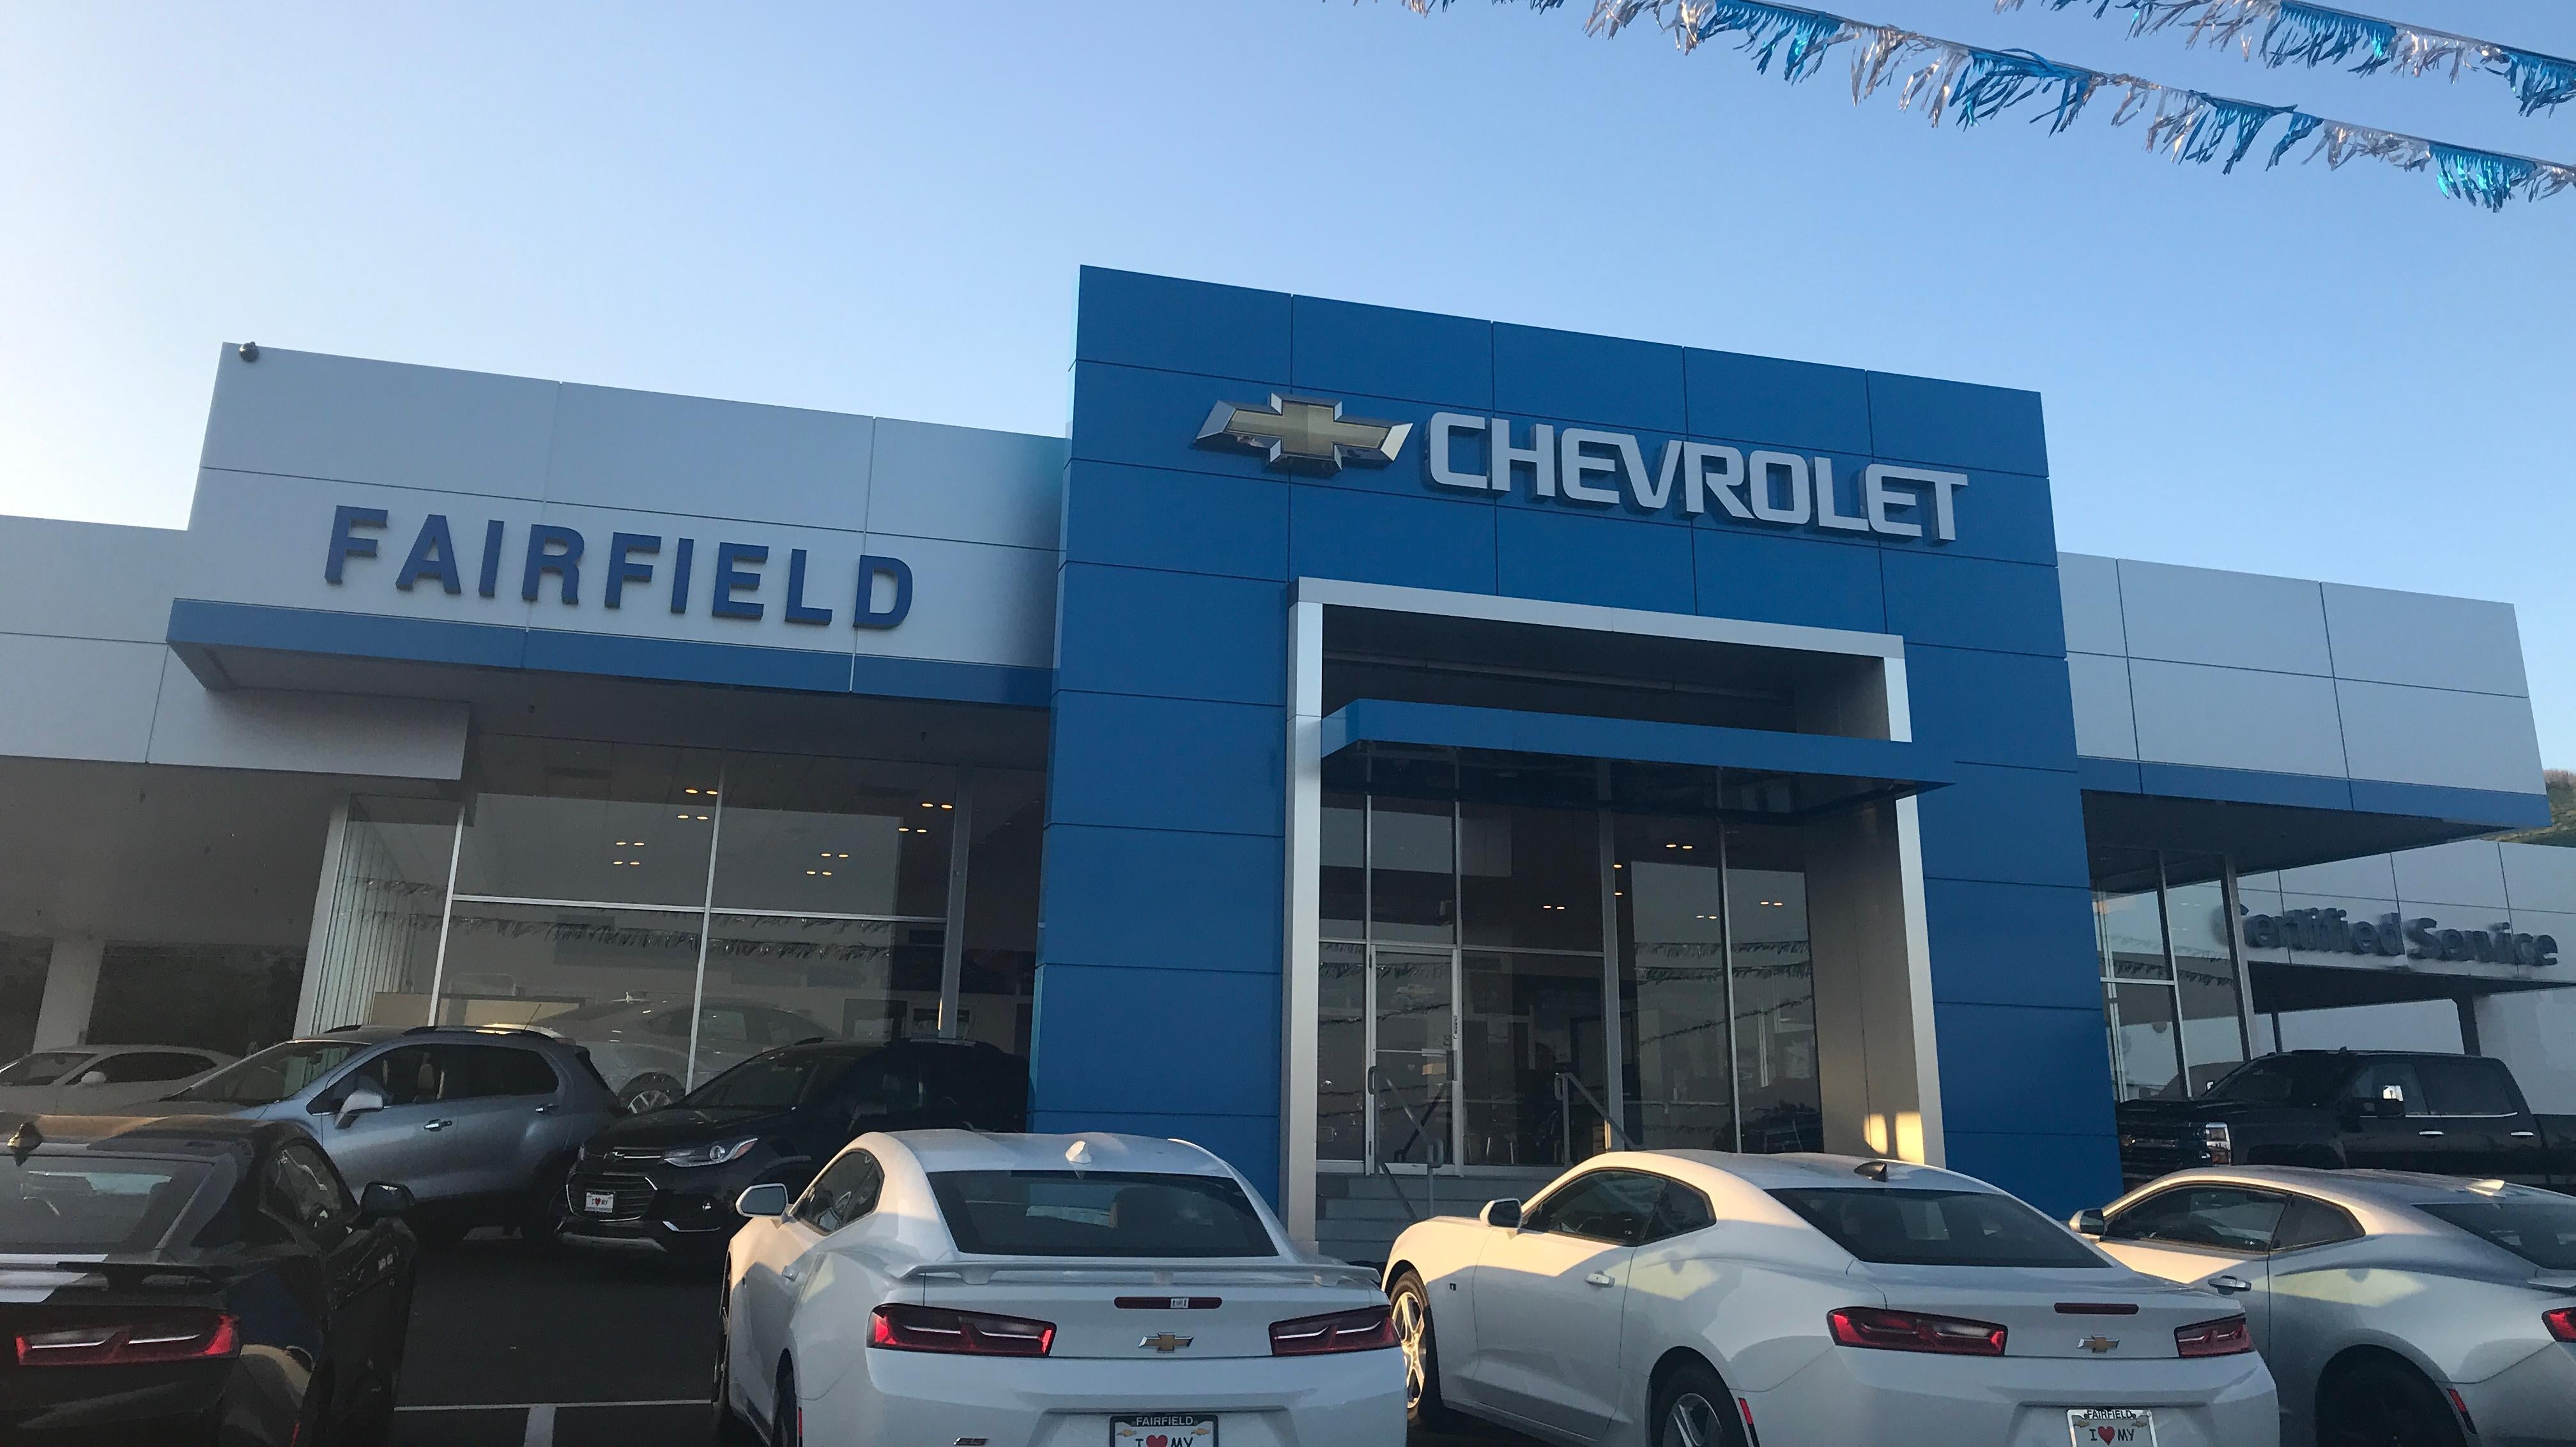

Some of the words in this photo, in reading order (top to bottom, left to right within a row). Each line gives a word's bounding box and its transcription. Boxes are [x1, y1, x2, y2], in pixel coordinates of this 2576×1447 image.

[1426, 411, 1968, 544] CHEVROLET
[324, 505, 914, 629] FAIRFIELD
[2404, 917, 2558, 967] Service
[1135, 1416, 1193, 1426] FAIRFIELD
[2087, 1409, 2133, 1420] FAIRFIELD
[2089, 1428, 2097, 1441] I
[2117, 1428, 2135, 1441] MY
